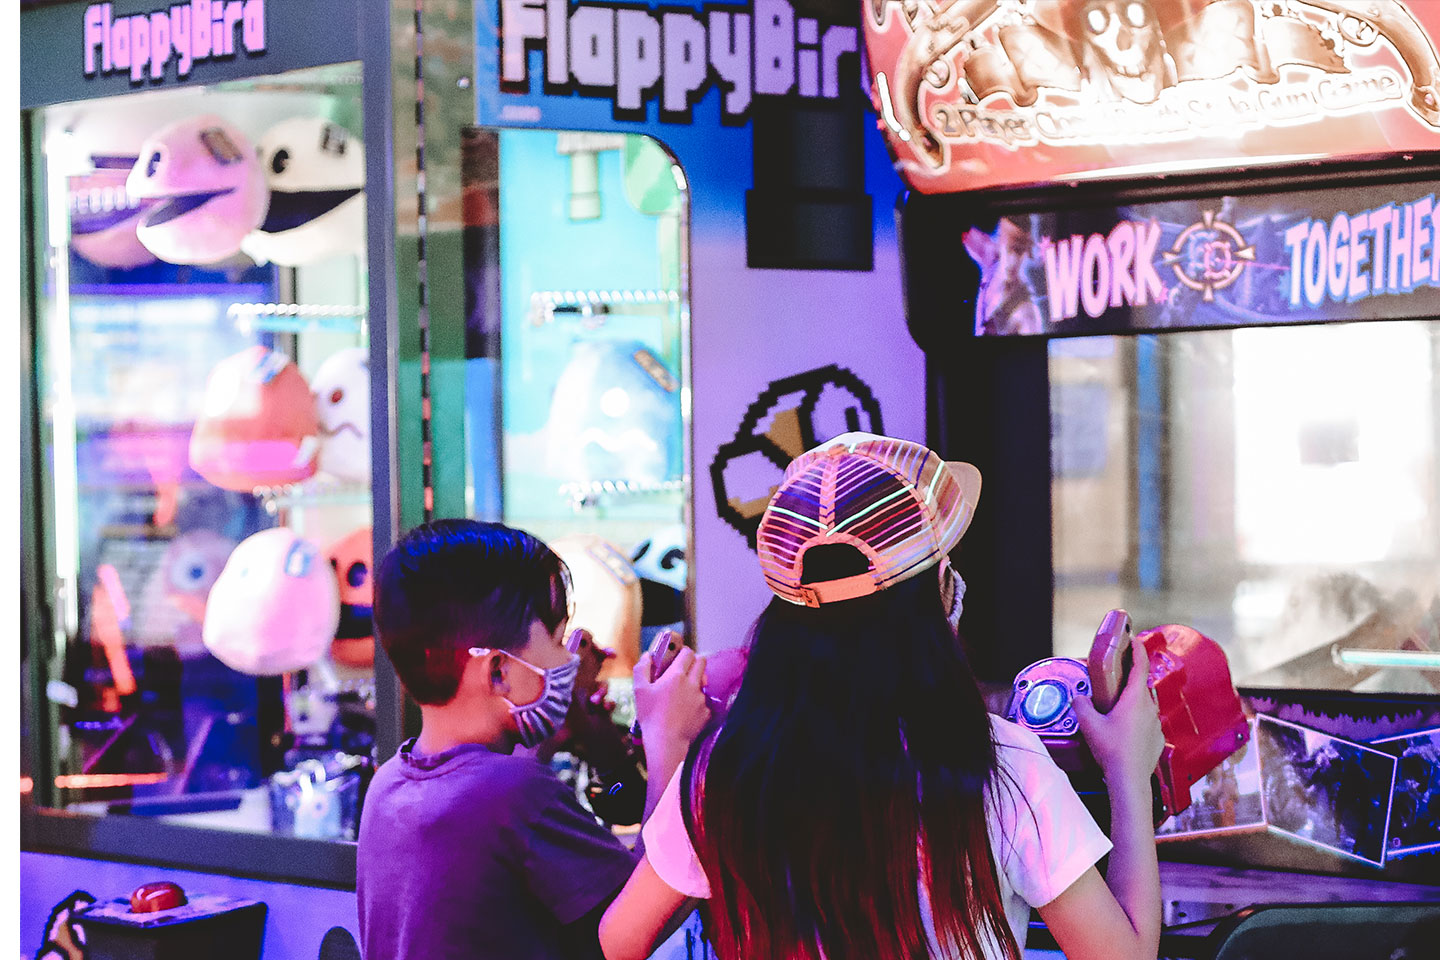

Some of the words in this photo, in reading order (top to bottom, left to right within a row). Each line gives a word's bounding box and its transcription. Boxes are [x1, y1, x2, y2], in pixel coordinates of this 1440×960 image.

[83, 0, 266, 83] FlappyBird
[501, 0, 870, 116] FlappyBir
[1045, 217, 1163, 321] WORK
